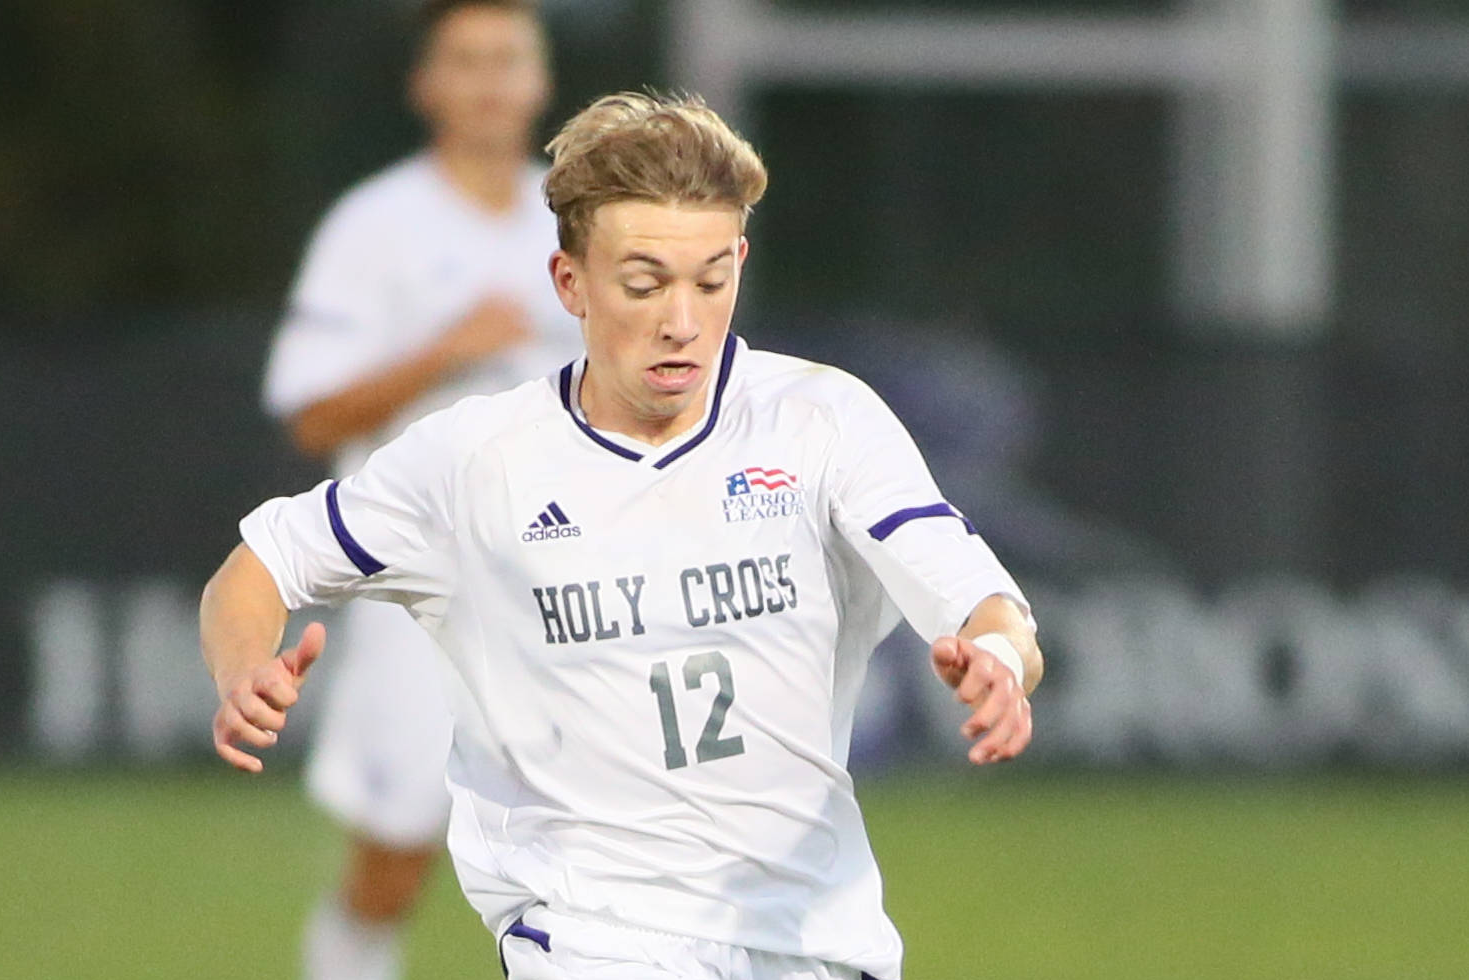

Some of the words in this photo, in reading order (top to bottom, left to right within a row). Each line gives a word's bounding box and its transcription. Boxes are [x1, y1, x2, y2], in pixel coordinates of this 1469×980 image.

[522, 526, 581, 542] adidas
[532, 575, 646, 644] HOLY
[680, 554, 798, 628] CROSS
[649, 650, 746, 771] 12
